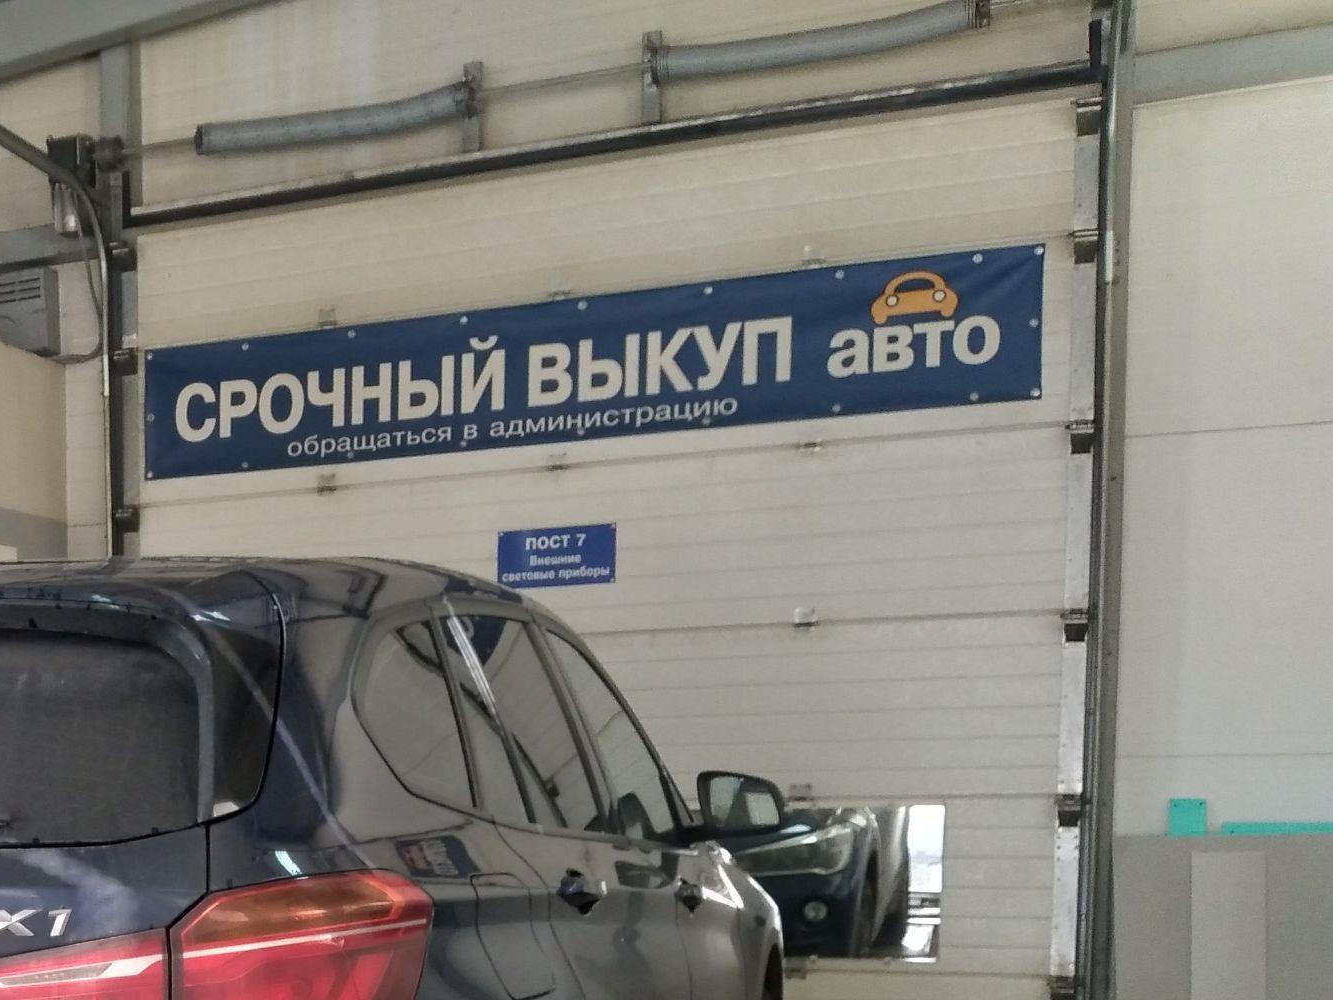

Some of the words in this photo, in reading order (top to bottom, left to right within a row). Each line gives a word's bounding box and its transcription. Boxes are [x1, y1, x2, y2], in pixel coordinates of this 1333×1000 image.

[174, 336, 506, 443] СРОЧНЫЙ
[528, 316, 793, 406] ВЫКУП
[827, 315, 1001, 379] авто
[286, 424, 452, 459] обращаться
[463, 424, 478, 440] в
[489, 397, 738, 438] администрацию
[525, 534, 571, 551] ПОСТ
[576, 533, 587, 547] 7
[502, 570, 556, 582] световые
[558, 565, 610, 580] приборы
